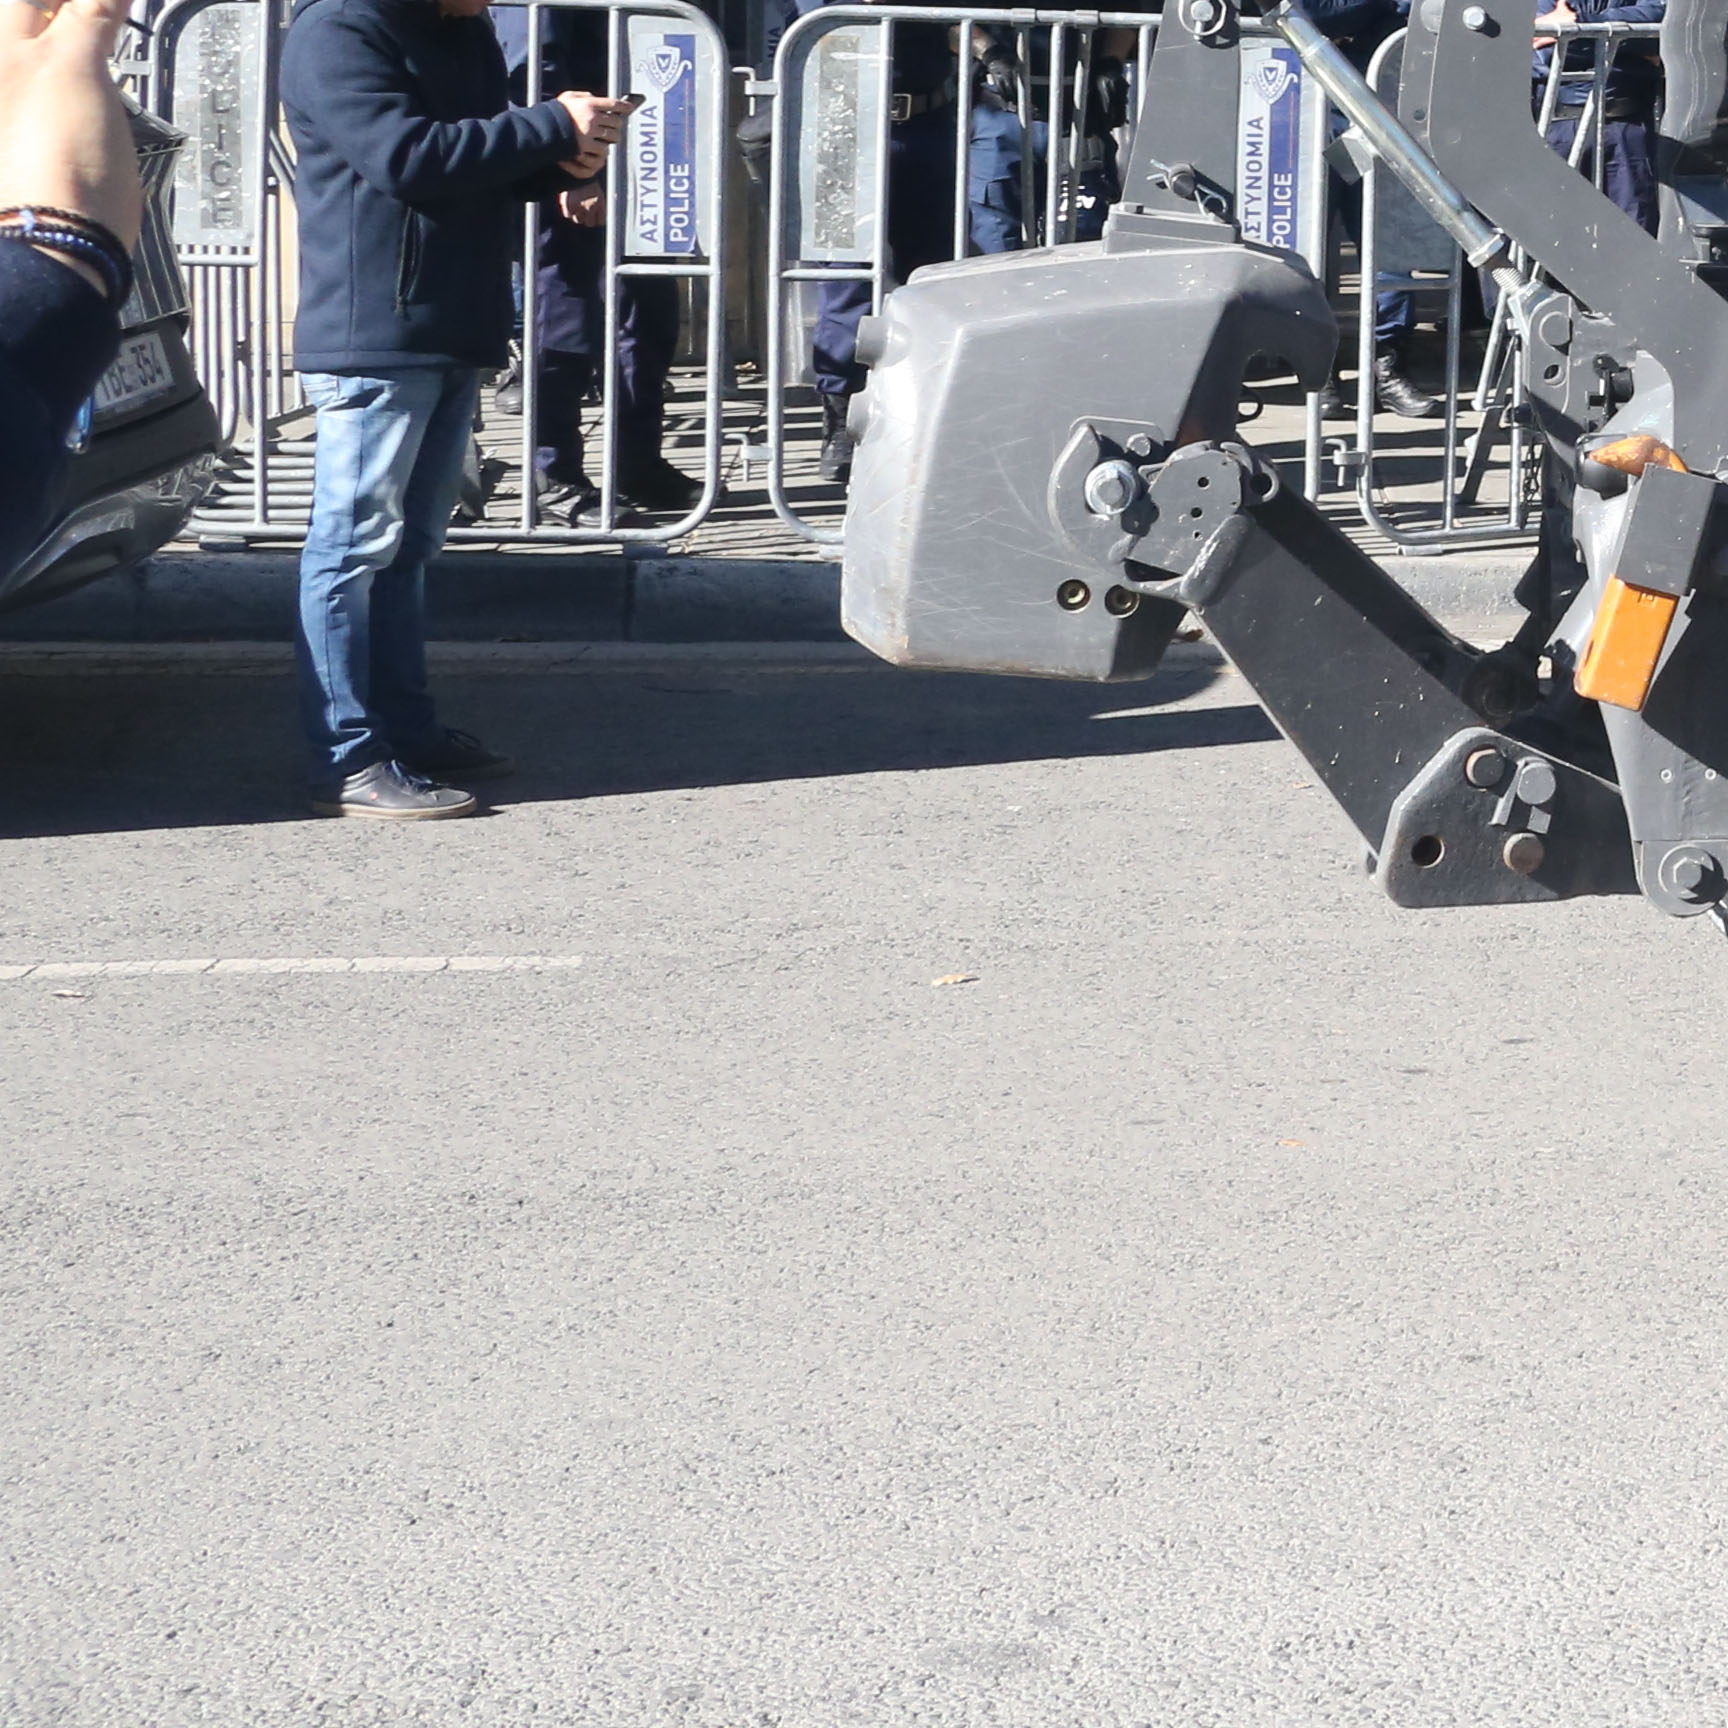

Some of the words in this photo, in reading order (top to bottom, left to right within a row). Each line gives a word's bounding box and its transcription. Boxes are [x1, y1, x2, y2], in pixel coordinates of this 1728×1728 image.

[640, 106, 658, 243] ΑΣΤΥΝΟΜΙΑ
[669, 163, 690, 243] POLICE
[1244, 116, 1264, 239] ΣΤΥΝΟΜΙΑ
[1273, 173, 1292, 248] POLICE
